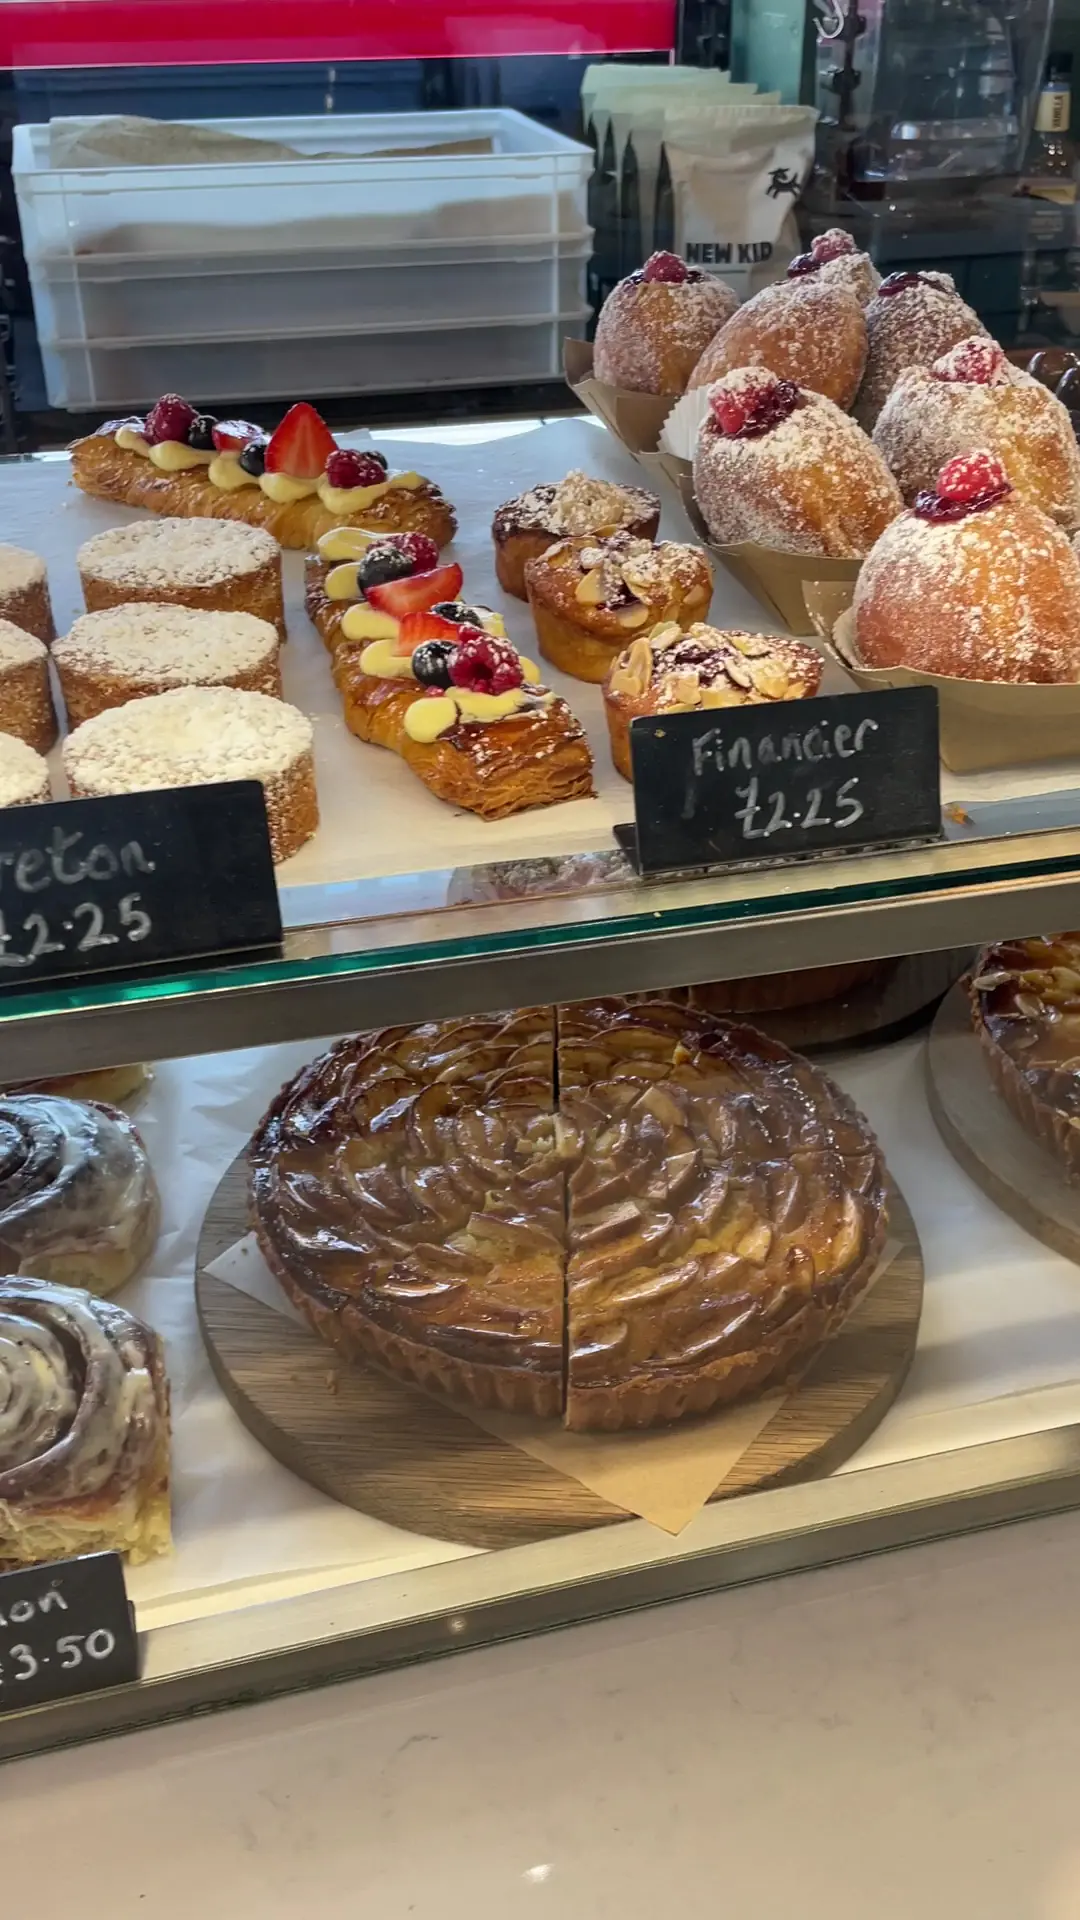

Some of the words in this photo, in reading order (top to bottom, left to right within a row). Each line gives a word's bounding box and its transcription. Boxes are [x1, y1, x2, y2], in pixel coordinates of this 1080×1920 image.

[686, 243, 732, 264] NEW
[738, 242, 773, 263] KID
[692, 717, 879, 776] Financier
[734, 776, 865, 840] £2.25
[0, 1590, 69, 1627] on
[0, 1628, 116, 1684] 3.50
